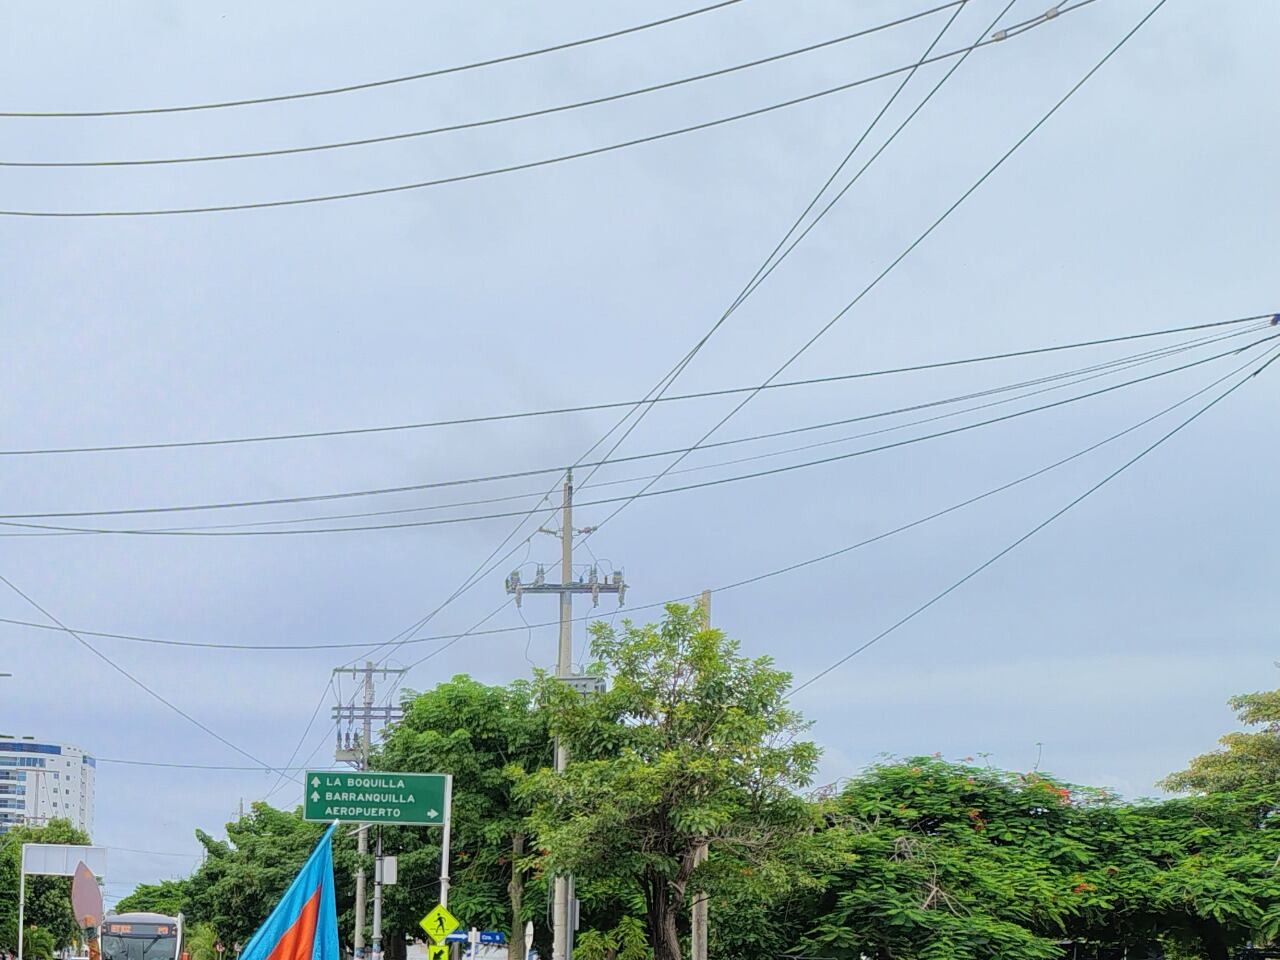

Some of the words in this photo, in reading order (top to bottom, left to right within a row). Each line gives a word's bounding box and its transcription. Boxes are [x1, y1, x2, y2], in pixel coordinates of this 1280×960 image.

[326, 777, 341, 786] LA
[347, 778, 405, 788] BOQUILLA
[325, 792, 415, 803] BARRANQUILLA
[325, 807, 401, 817] AEROPUERTO
